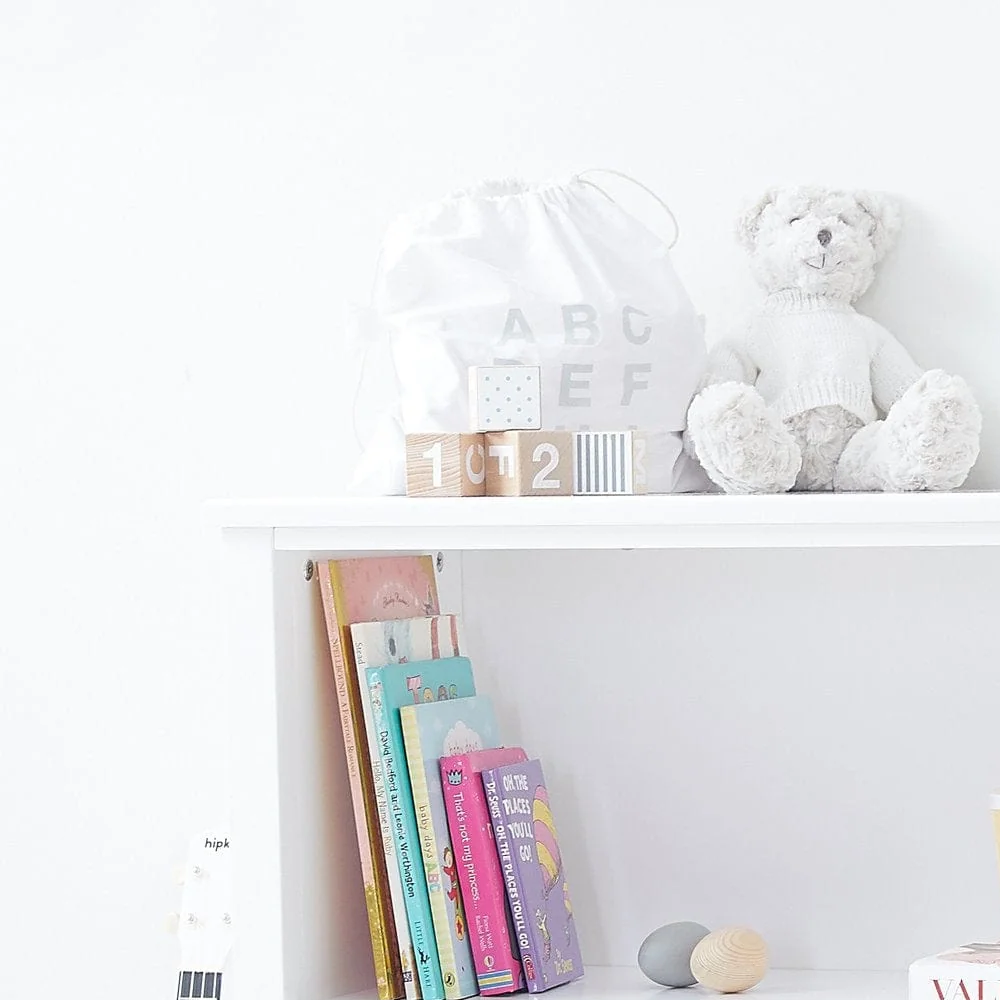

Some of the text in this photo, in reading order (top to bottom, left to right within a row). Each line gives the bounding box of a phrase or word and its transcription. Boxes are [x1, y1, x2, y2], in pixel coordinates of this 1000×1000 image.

[501, 304, 652, 345] A B C
[558, 363, 652, 407] E F
[423, 442, 442, 487] 1
[532, 443, 561, 489] 2
[355, 642, 366, 665] Stead
[486, 781, 502, 818] Dr. Seuss
[502, 798, 531, 815] PLACES
[380, 730, 415, 898] David Bedford and Leonie Worthington
[419, 805, 430, 831] baby
[204, 837, 230, 852] hipk
[459, 824, 471, 843] not
[423, 836, 434, 859] days
[462, 845, 473, 861] my
[500, 842, 511, 861] THE
[504, 863, 518, 898] PLACES
[519, 933, 530, 949] GO!
